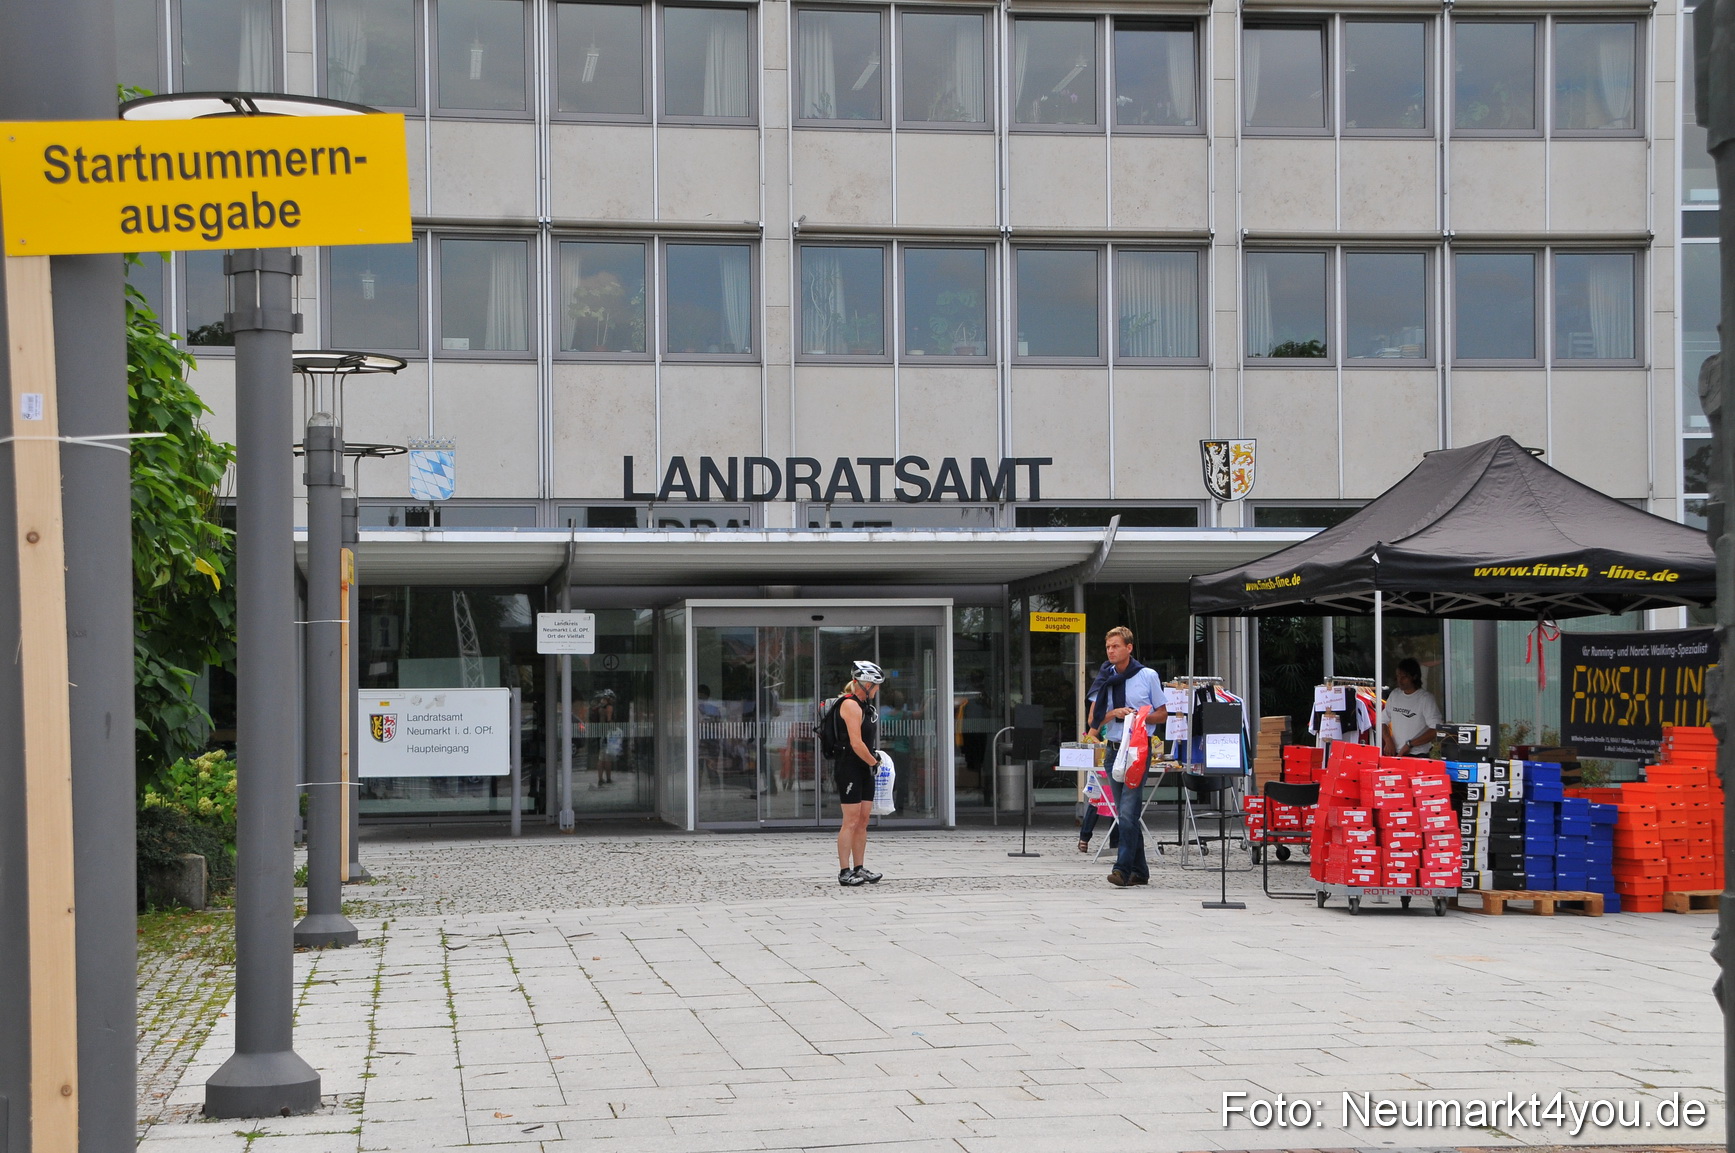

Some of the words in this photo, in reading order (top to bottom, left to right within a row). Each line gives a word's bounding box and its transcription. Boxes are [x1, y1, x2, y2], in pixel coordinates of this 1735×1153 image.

[43, 144, 368, 185] Startnummern-
[120, 191, 302, 242] ausgabe
[623, 455, 1053, 503] LANDRATSAMT
[1473, 563, 1590, 578] www.finish
[1600, 565, 1680, 583] -line.de
[1035, 614, 1081, 623] Startnummern-
[1591, 646, 1616, 659] Running-
[1617, 645, 1629, 656] und
[1630, 644, 1650, 656] Nordic
[1650, 642, 1708, 658] Walking-Spezialist
[406, 712, 464, 722] Landratsamt
[406, 726, 450, 736] Neumarkt
[454, 726, 460, 735] i.
[462, 726, 472, 735] d.
[474, 726, 494, 735] OPf.
[406, 744, 470, 754] Haupteingang
